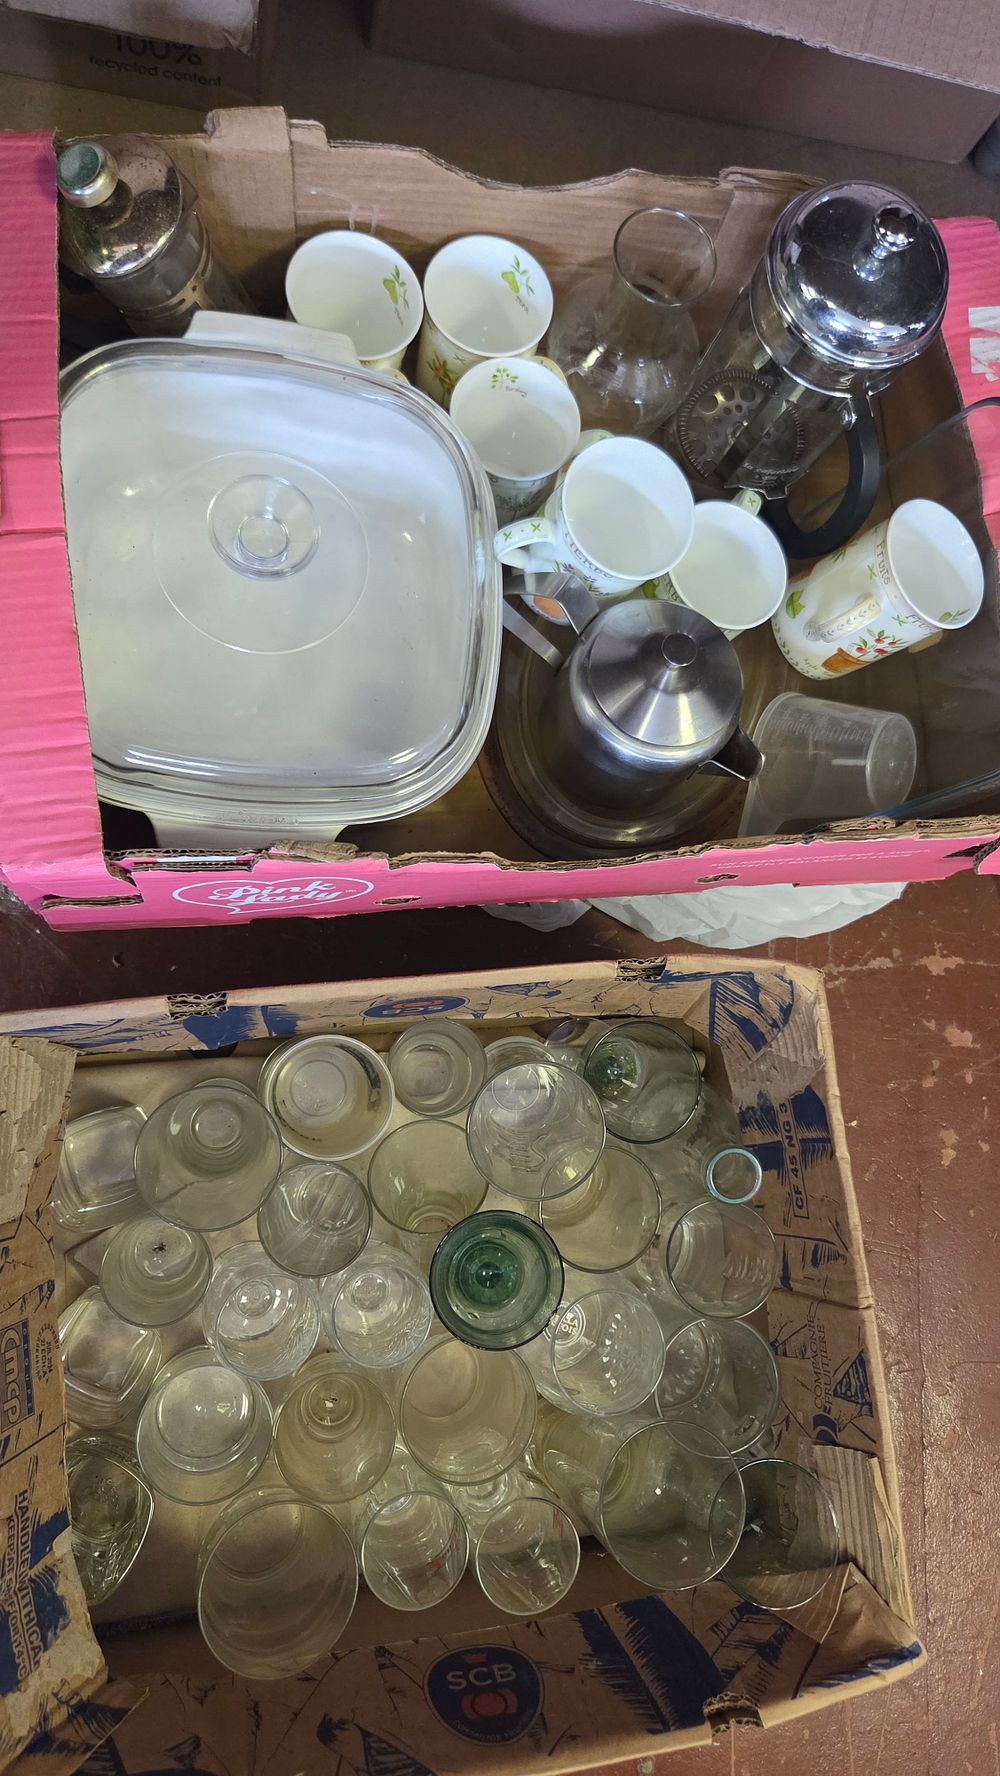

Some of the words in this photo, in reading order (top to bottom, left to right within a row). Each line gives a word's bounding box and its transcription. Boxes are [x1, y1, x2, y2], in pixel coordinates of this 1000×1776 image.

[89, 56, 159, 78] recycled
[162, 69, 222, 87] content
[876, 539, 891, 585] Fruits
[208, 881, 337, 900] Pink
[227, 890, 343, 906] Lady
[778, 1102, 788, 1114] 3
[782, 1121, 795, 1148] NG
[788, 1155, 799, 1179] 45
[793, 1184, 804, 1210] CF
[0, 1327, 21, 1424] Cmcp
[807, 1315, 823, 1410] COMPAGNIE
[6, 1515, 16, 1552] KEEP
[18, 1489, 32, 1572] HANDLE
[5, 1555, 15, 1573] AT
[18, 1574, 36, 1626] WITH
[9, 1615, 20, 1636] OR
[445, 1663, 517, 1690] SCB
